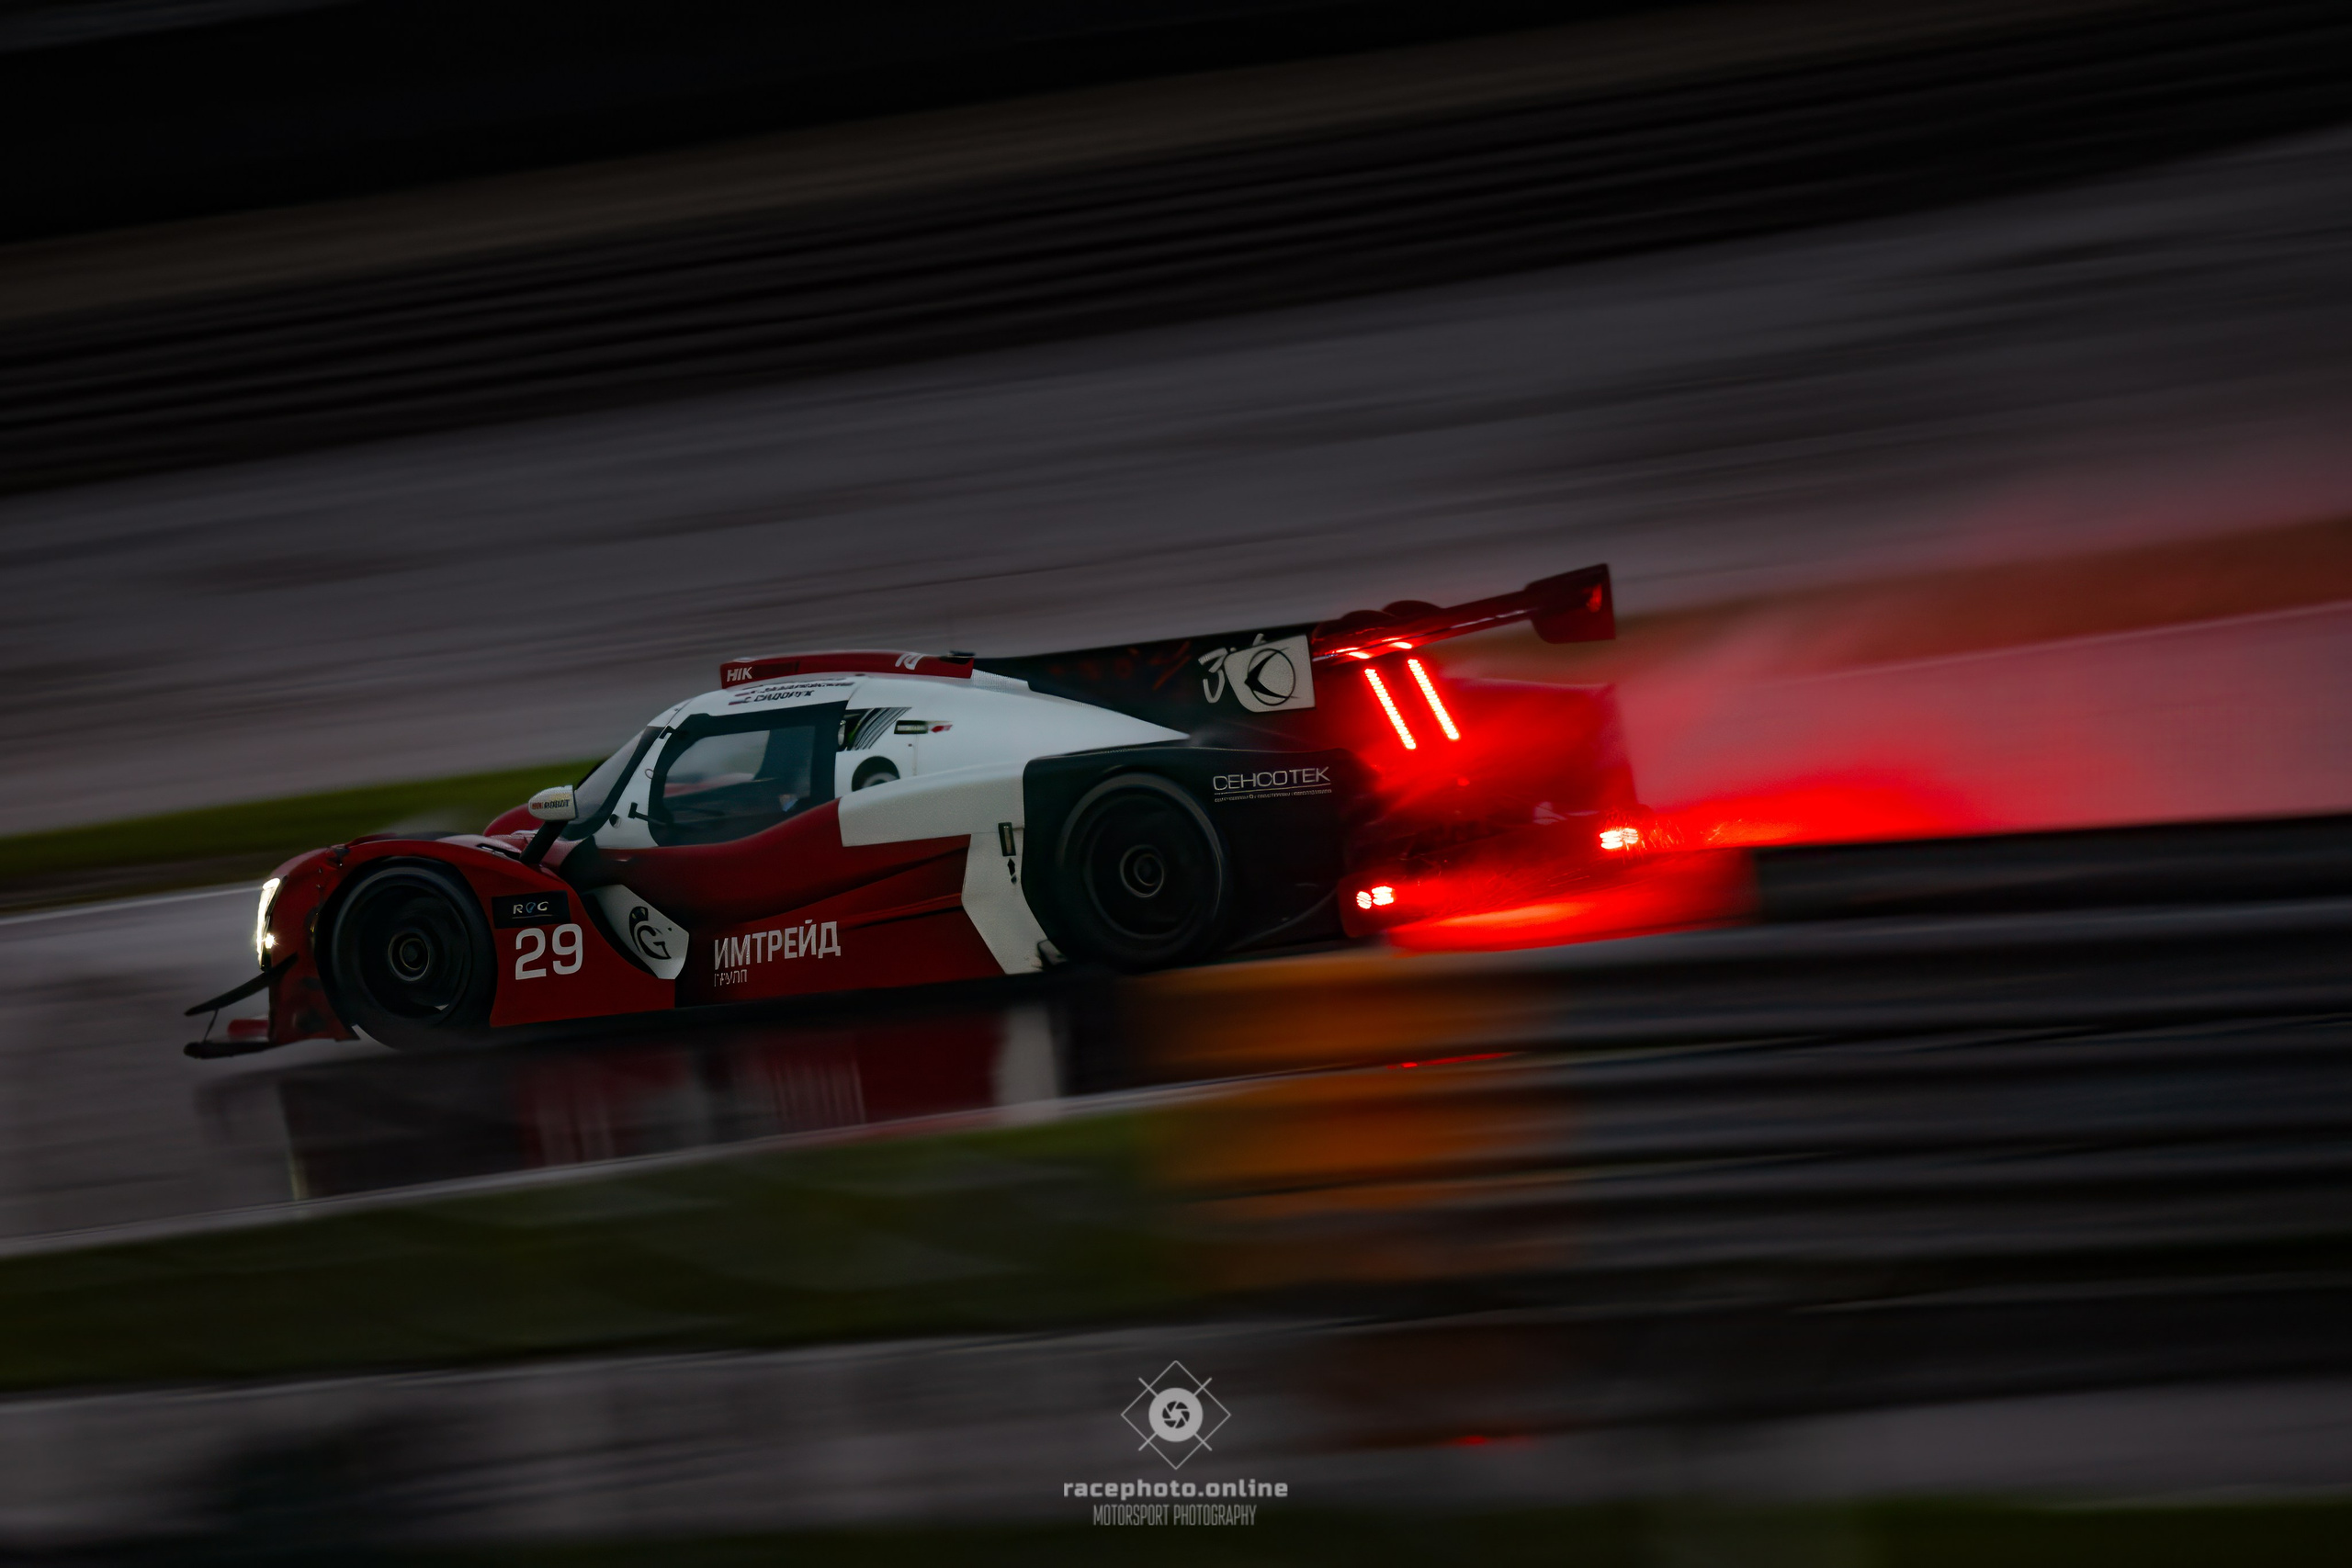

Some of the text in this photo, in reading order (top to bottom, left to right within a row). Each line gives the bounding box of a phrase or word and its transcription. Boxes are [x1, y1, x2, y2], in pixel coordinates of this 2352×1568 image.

[727, 666, 753, 682] HIK
[1213, 766, 1331, 791] СЕНСОТЕК
[514, 923, 583, 980] 29
[714, 919, 842, 970] ИМТРЕЙД
[713, 968, 748, 987] ГРУПП
